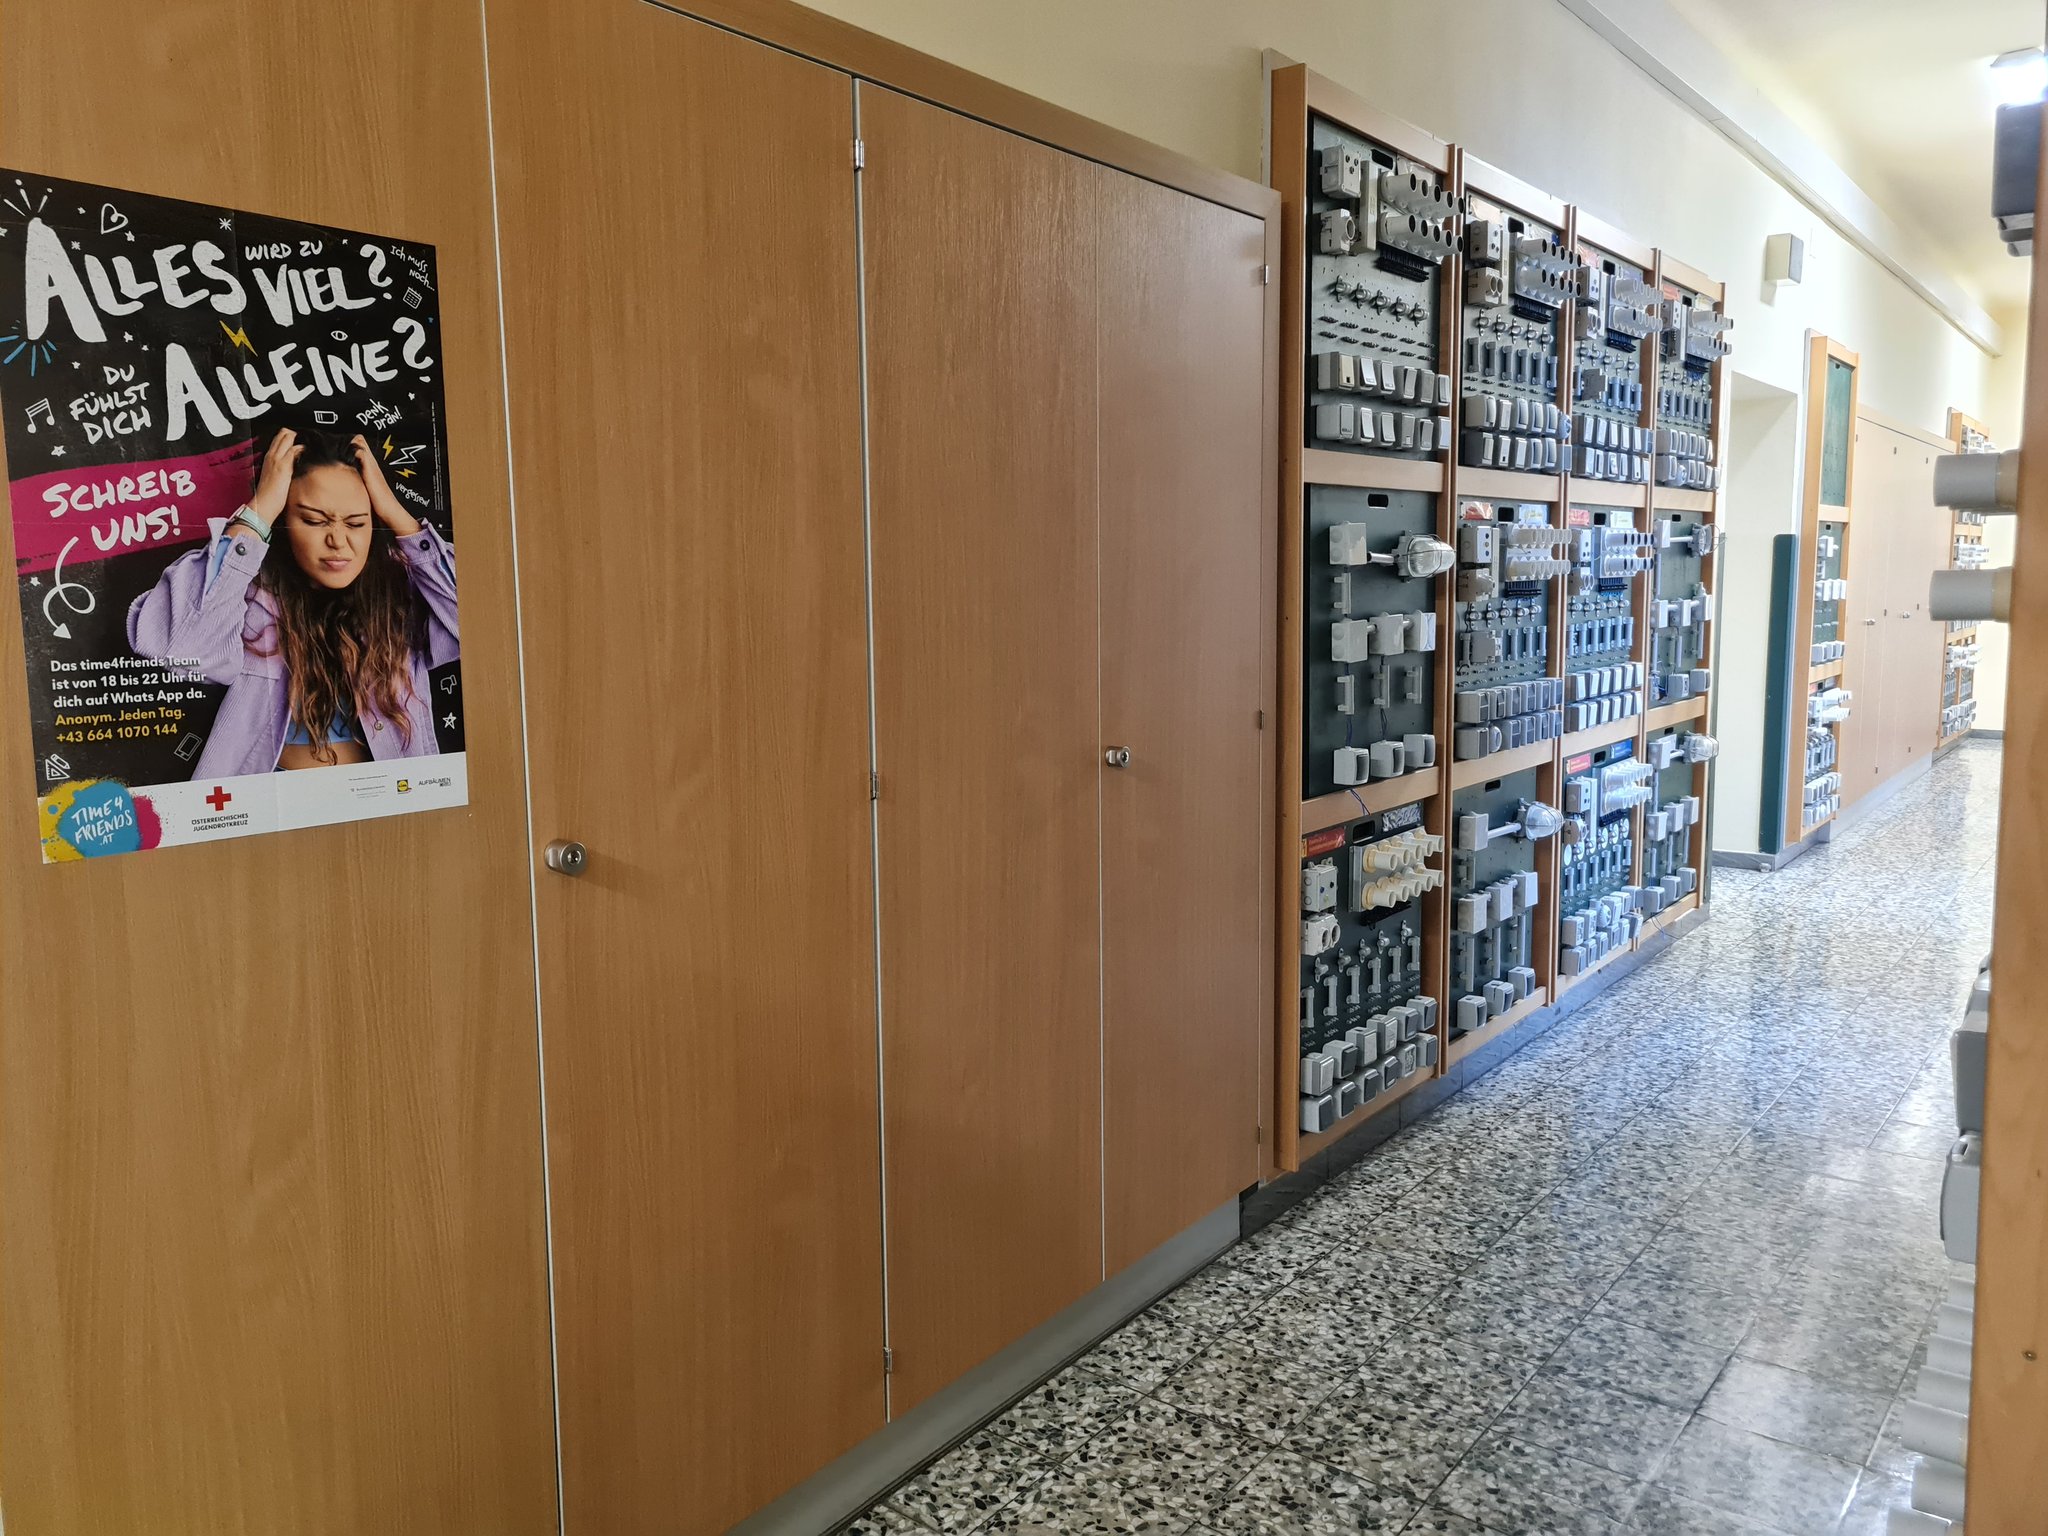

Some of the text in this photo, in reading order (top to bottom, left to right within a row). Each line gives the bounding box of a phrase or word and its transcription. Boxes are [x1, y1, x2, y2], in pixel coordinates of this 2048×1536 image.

[245, 240, 323, 261] WIRD ZU
[390, 245, 406, 261] Ich
[25, 217, 247, 343] ALLES
[252, 244, 393, 327] VIEL?
[103, 364, 136, 385] DU
[165, 316, 434, 442] ALLEINE?
[69, 382, 150, 421] FÜHLST
[82, 406, 152, 444] DICH
[42, 469, 197, 518] SCHREIB
[91, 504, 181, 551] UNS!
[50, 655, 201, 672] Das time4friends Team
[51, 671, 207, 690] ist von 18 bis 22 Uhr für
[53, 688, 207, 708] dich auf Whats App da.
[55, 707, 186, 726] Anonym. Jeden Tag.
[56, 723, 178, 743] +43 664 1070 144
[71, 796, 123, 826] TIME 4
[74, 809, 133, 844] FRIENDS
[193, 819, 248, 832] JUGENDROTKREUZ
[100, 833, 115, 846] .AT
